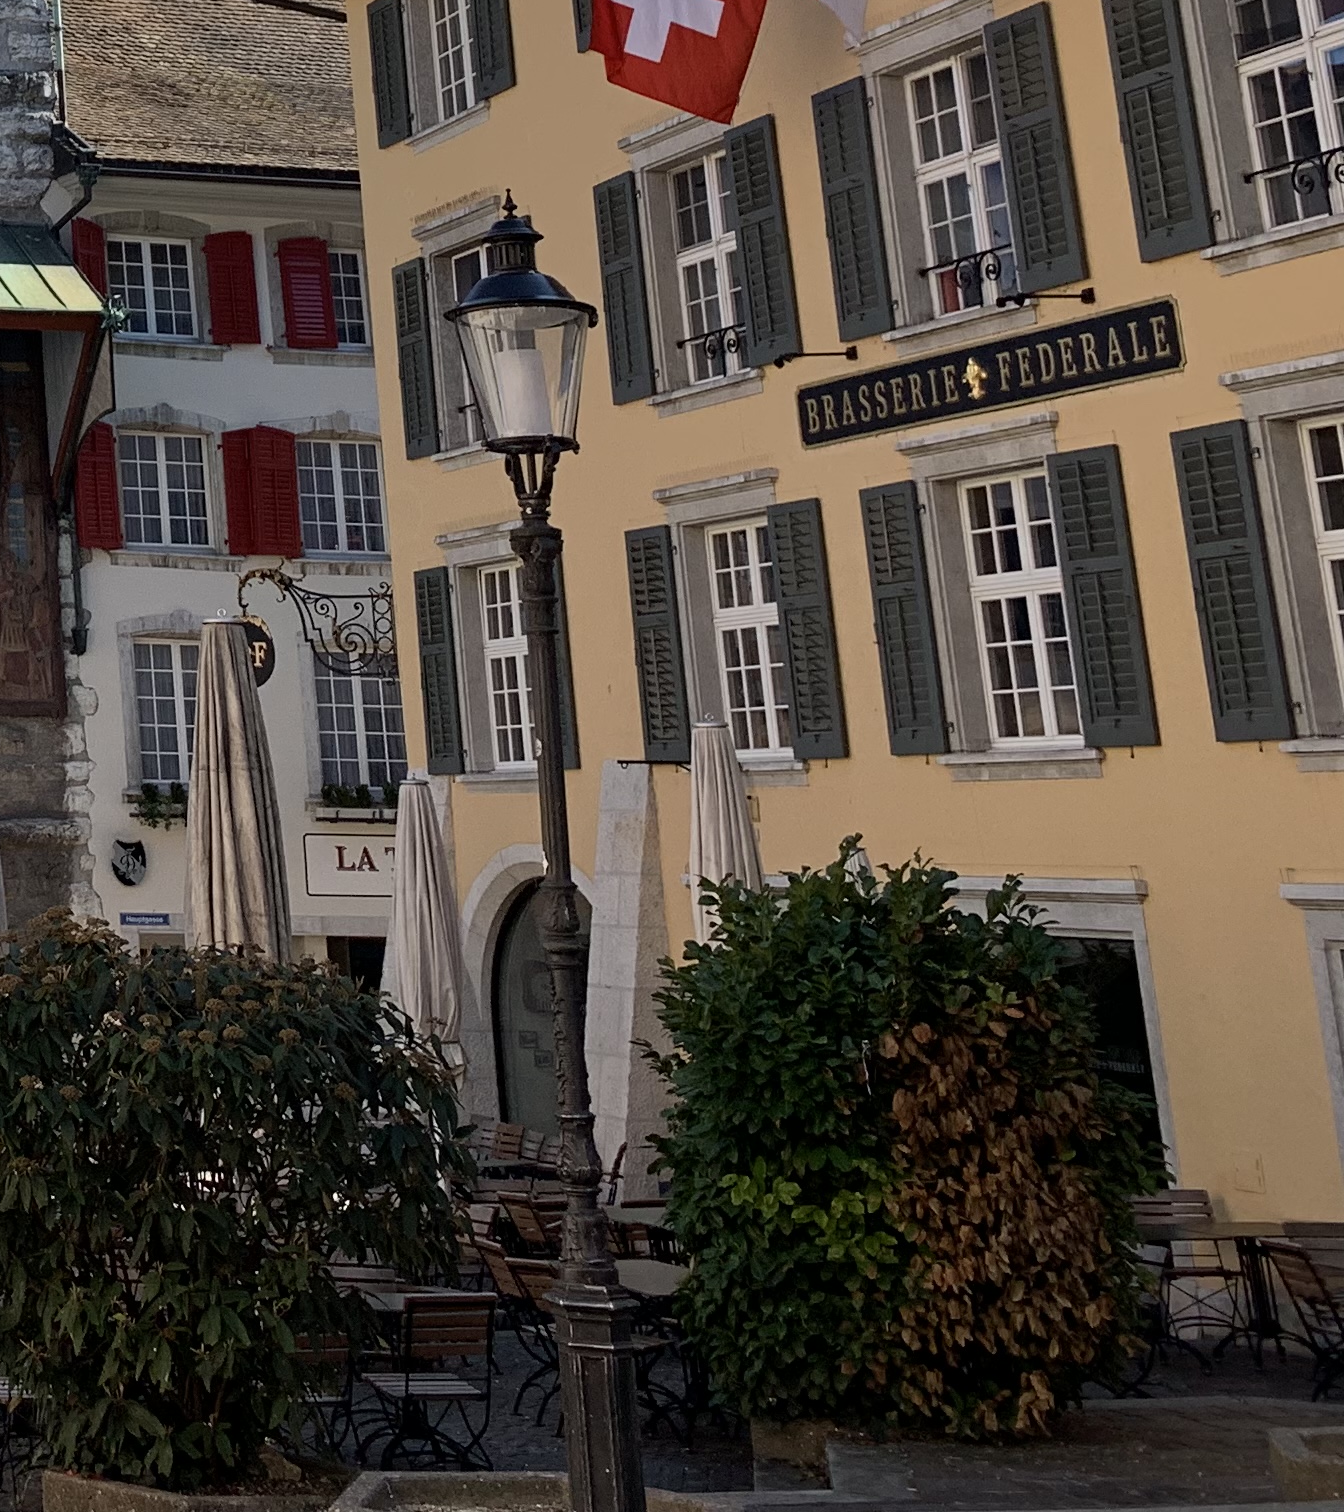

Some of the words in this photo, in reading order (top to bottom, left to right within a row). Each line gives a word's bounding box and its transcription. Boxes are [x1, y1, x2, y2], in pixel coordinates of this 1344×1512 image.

[805, 364, 960, 435] BRASSERIE
[995, 315, 1172, 391] FEDERALE
[334, 845, 380, 872] LA
[125, 915, 164, 924] Hauptgasse
